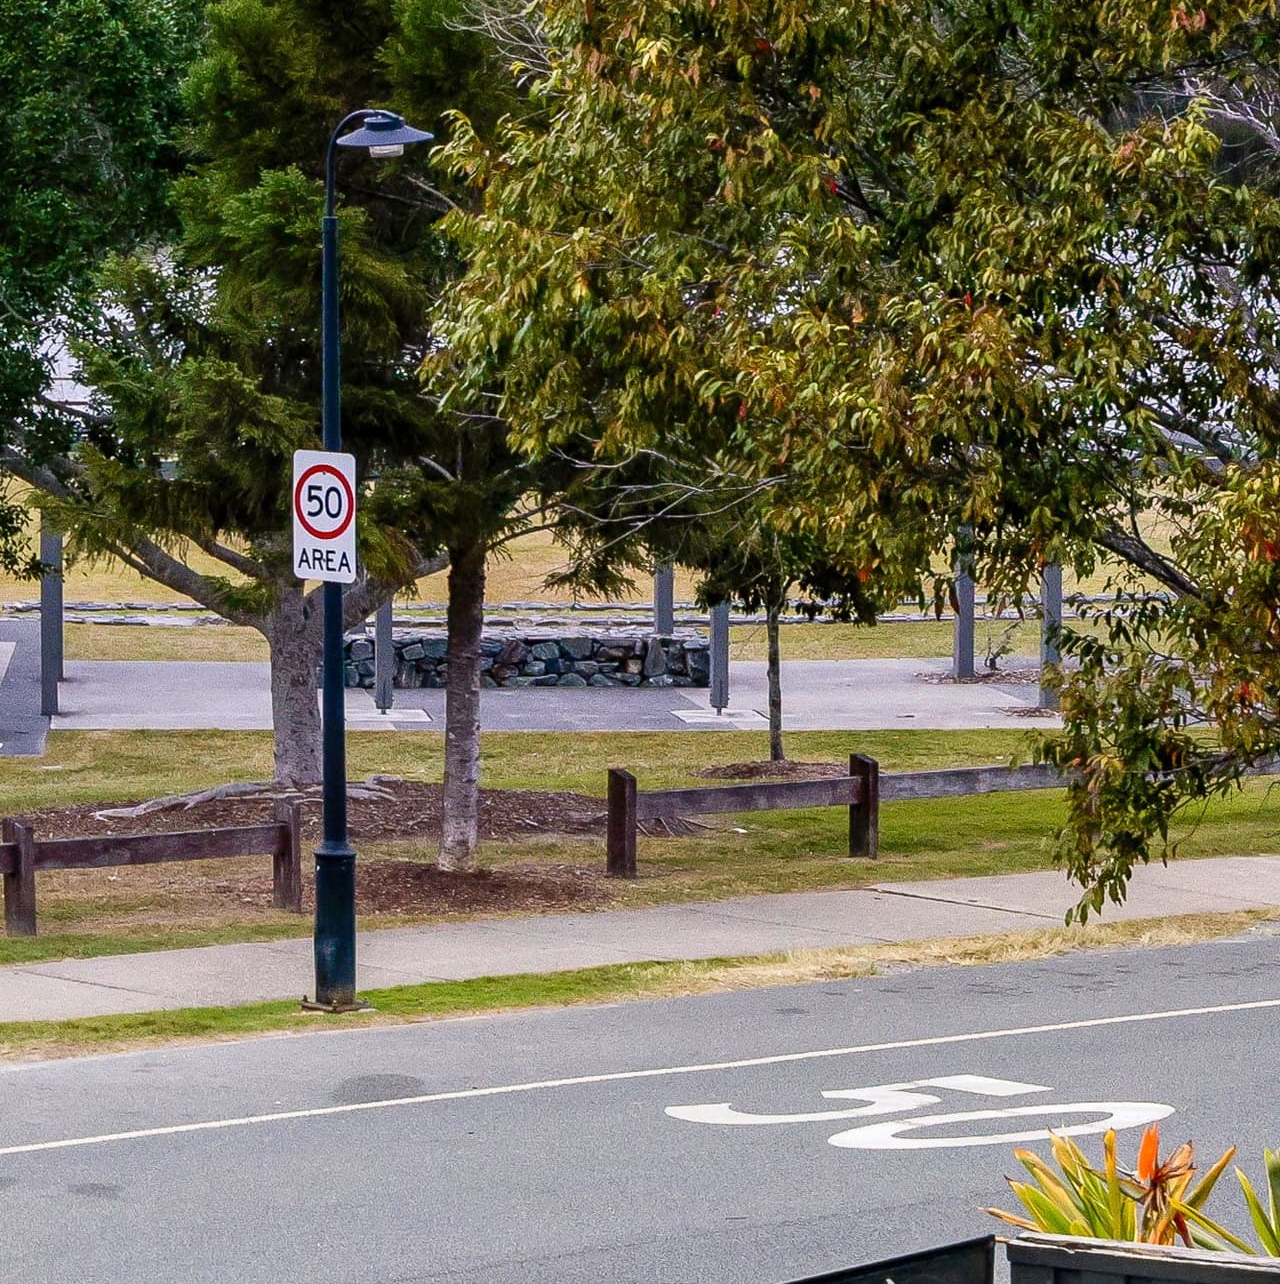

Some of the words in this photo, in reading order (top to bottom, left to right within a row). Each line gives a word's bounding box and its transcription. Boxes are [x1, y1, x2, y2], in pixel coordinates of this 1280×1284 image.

[307, 484, 342, 519] 50
[298, 547, 352, 574] AREA
[664, 1074, 1176, 1150] 50
